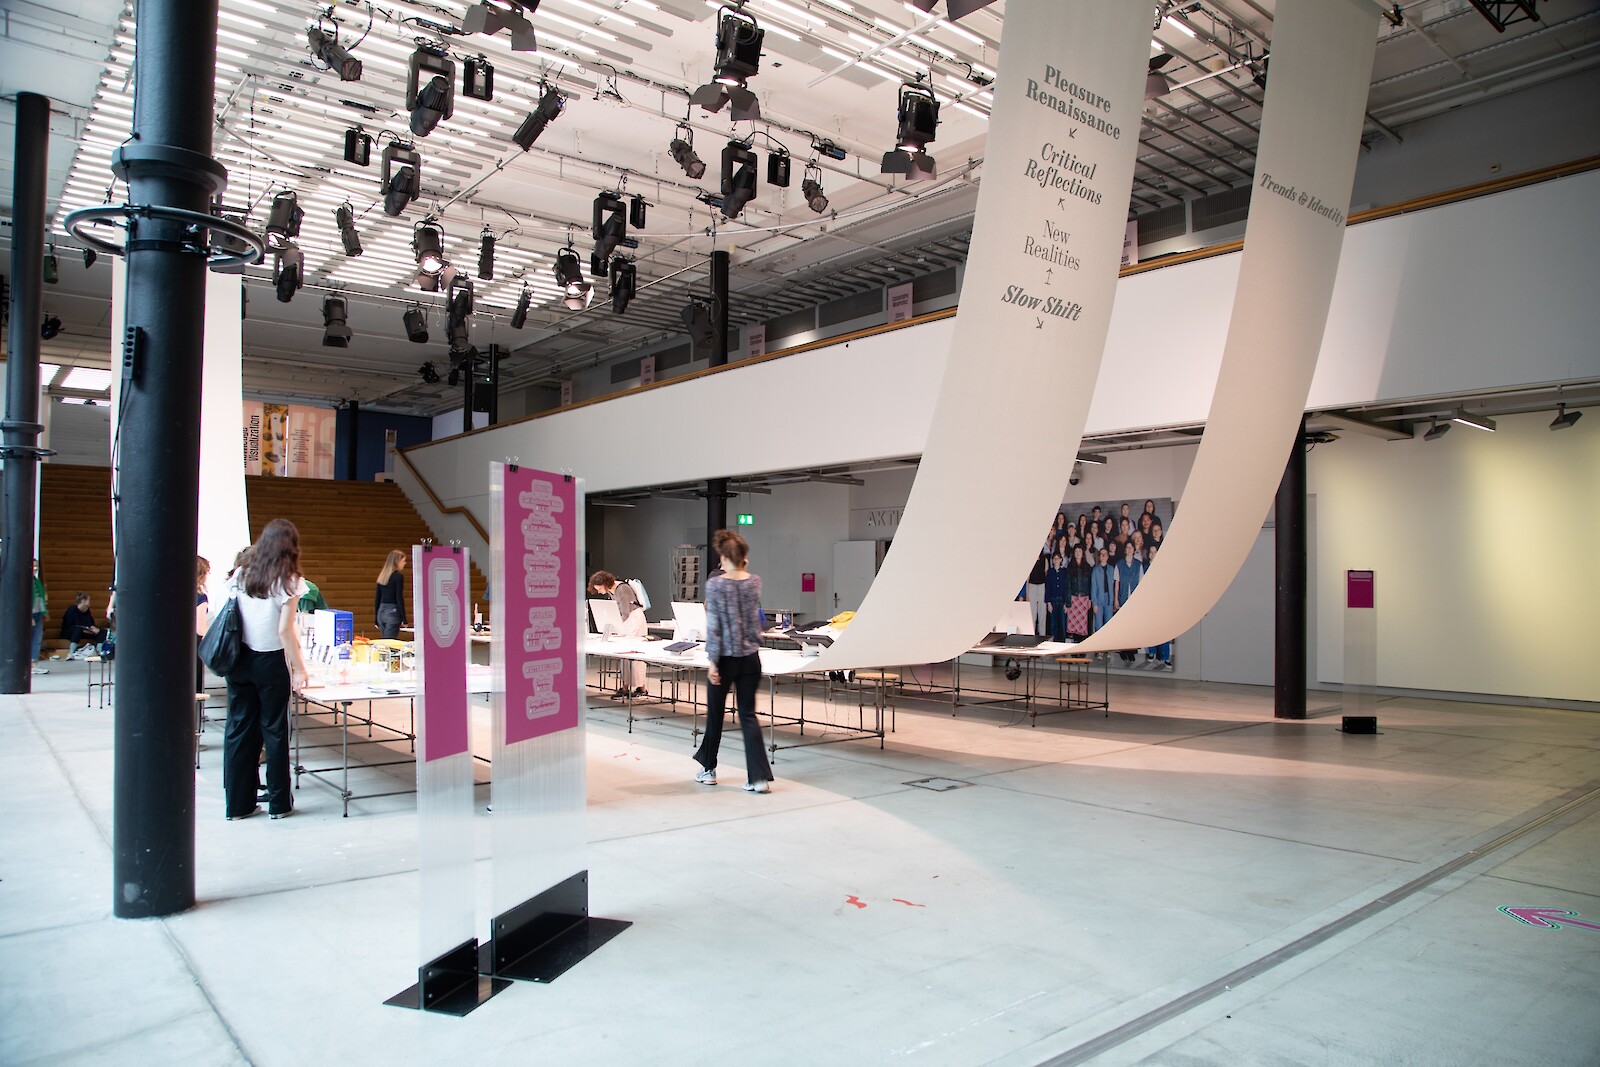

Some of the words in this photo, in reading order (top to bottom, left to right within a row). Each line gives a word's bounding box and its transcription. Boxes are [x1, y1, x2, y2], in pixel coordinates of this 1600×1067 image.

[1025, 78, 1120, 139] Renaissance
[1043, 64, 1111, 113] Pleasure
[1024, 158, 1102, 205] Reflections
[1041, 142, 1097, 180] Critical
[1260, 173, 1298, 201] Trends
[1298, 191, 1309, 206] &
[1307, 196, 1345, 227] Identity
[1023, 235, 1080, 271] Realities
[1043, 219, 1071, 244] New
[1001, 284, 1042, 310] Slow
[1041, 296, 1083, 321] Shift
[249, 415, 260, 461] Visualization
[431, 562, 457, 644] 5
